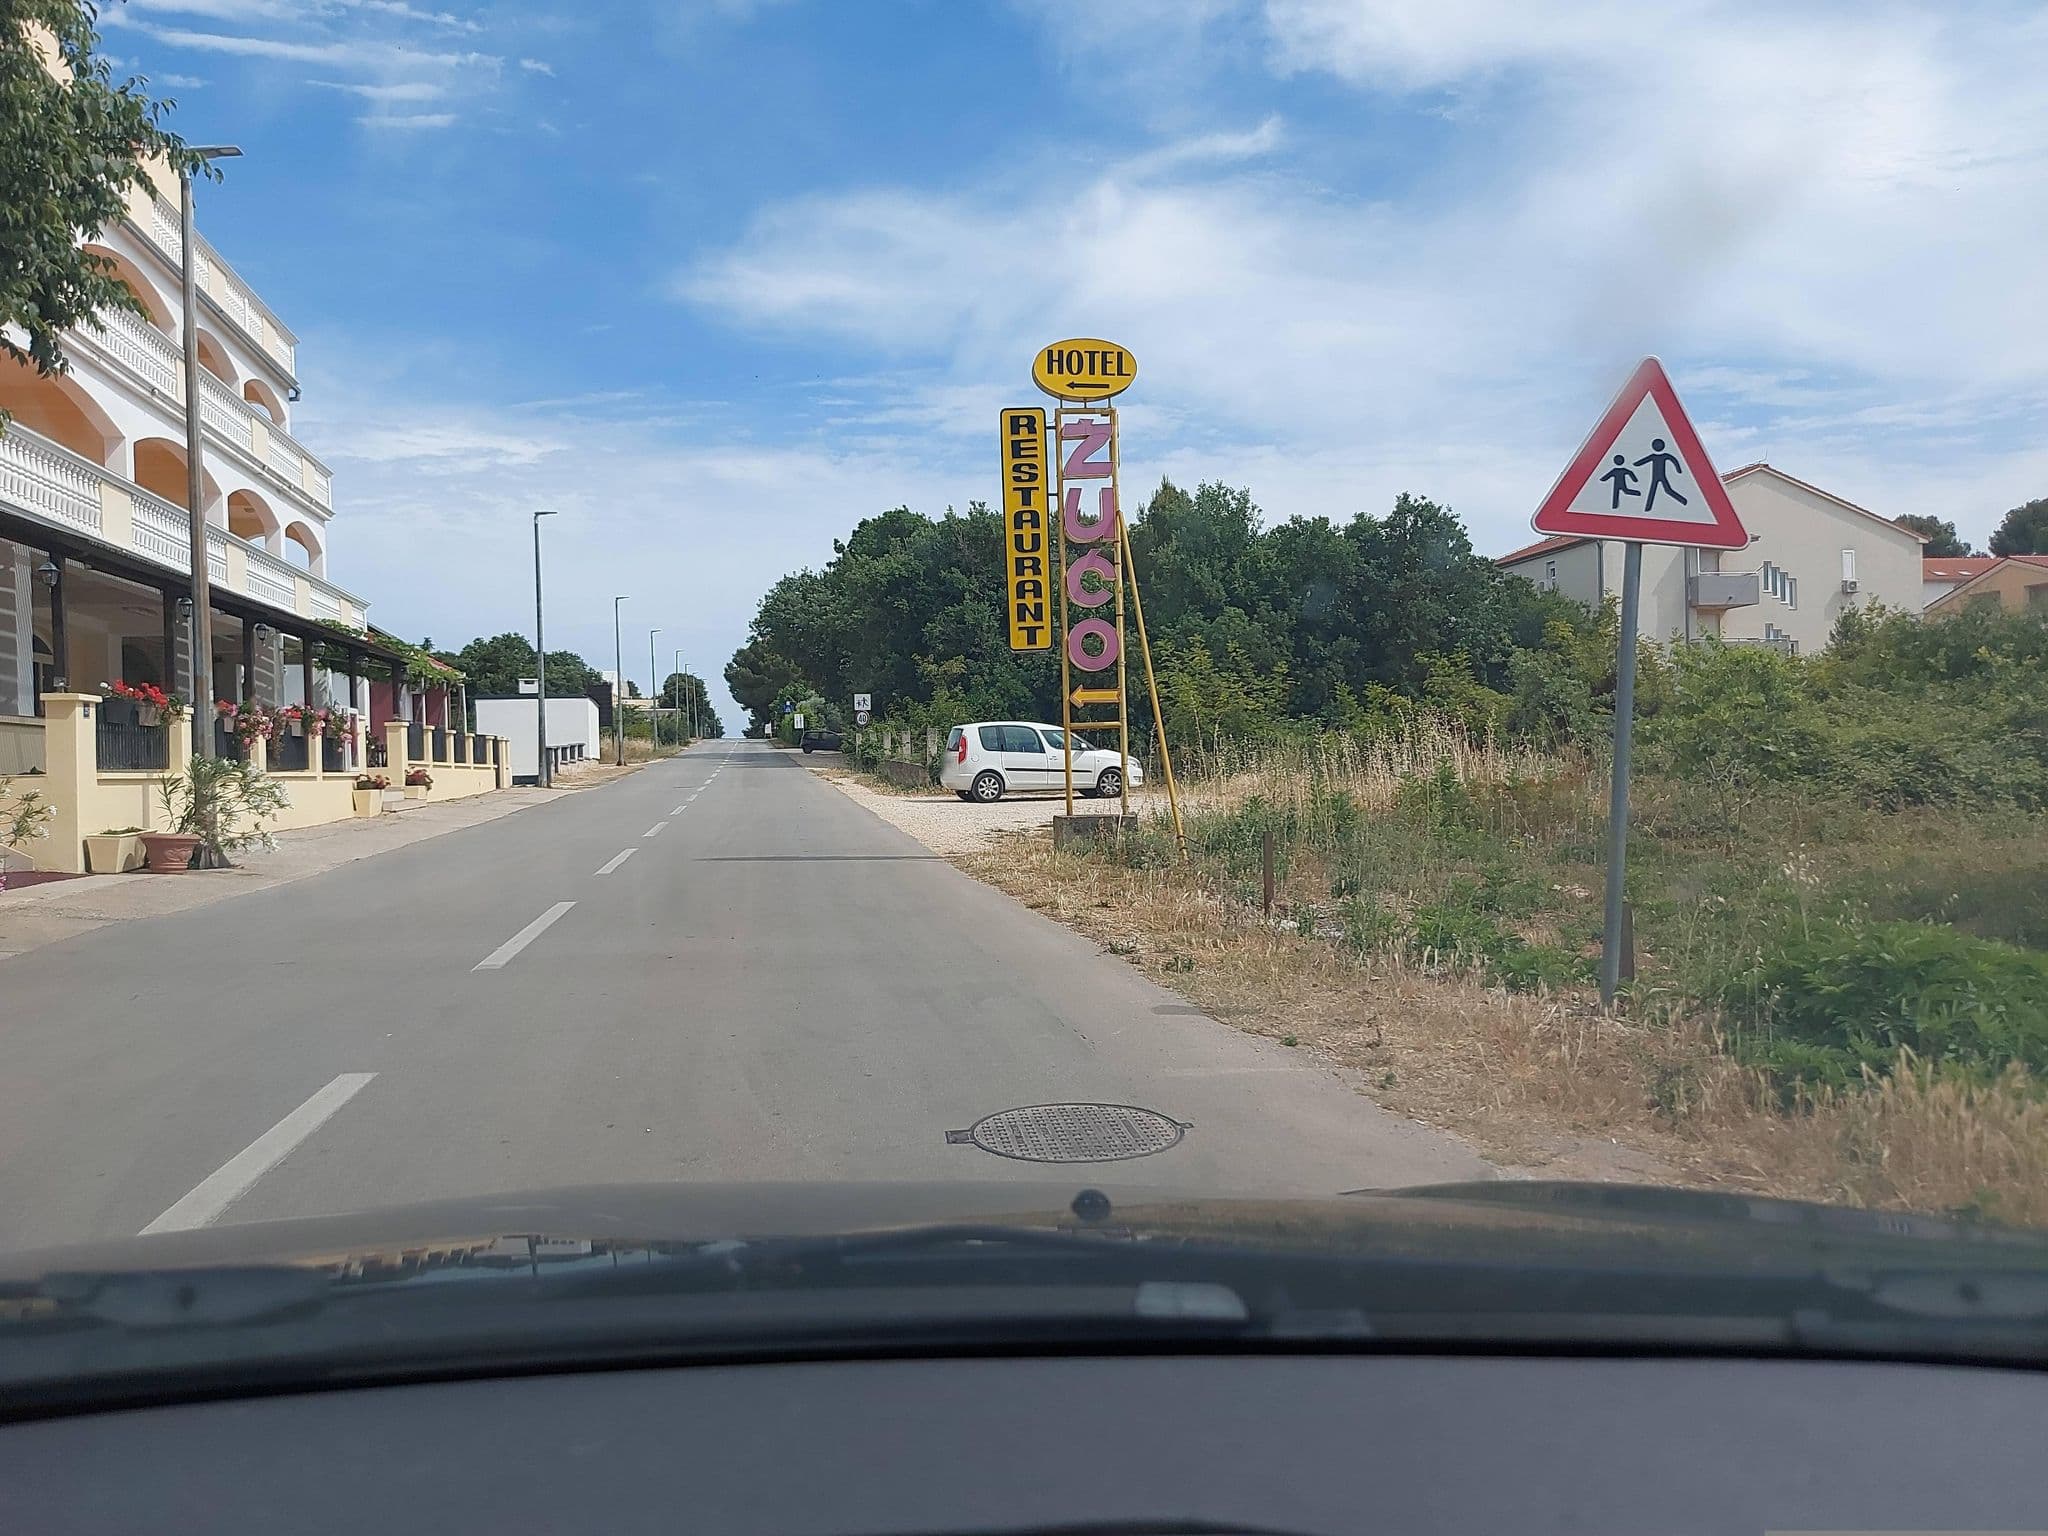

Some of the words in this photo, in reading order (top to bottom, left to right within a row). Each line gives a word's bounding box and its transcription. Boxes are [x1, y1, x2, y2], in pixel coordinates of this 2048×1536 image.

[1047, 349, 1131, 377] HOTEL
[1009, 414, 1045, 647] RESTAURANT
[858, 714, 867, 723] 40
